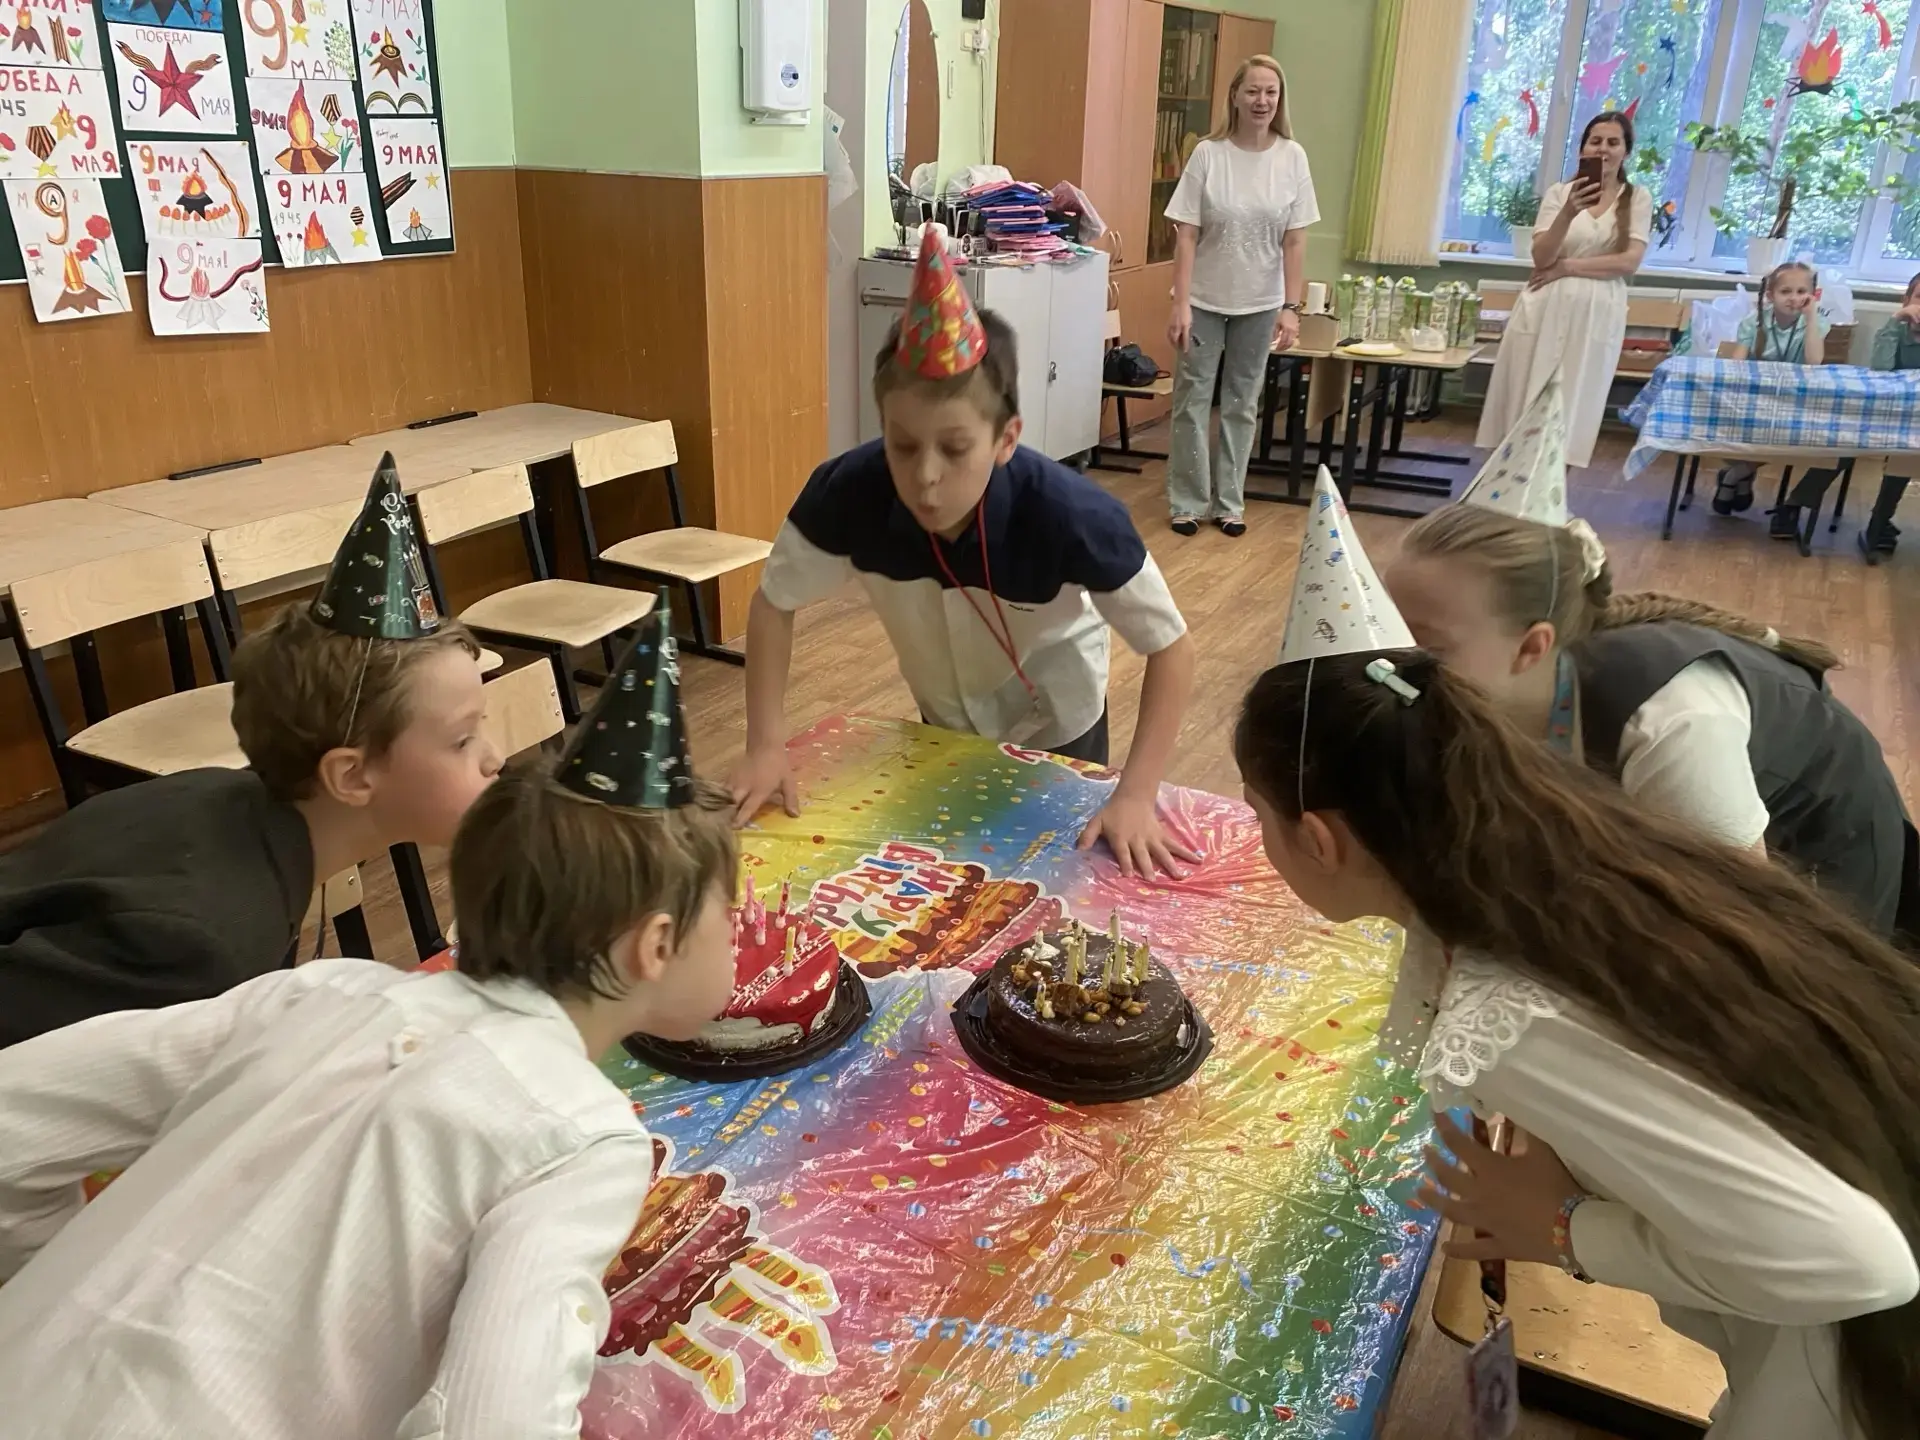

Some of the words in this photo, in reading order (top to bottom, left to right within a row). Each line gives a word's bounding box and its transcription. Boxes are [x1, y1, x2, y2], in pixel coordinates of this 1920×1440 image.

[135, 28, 192, 45] ПОБЕДА!
[291, 59, 336, 80] МАЯ
[127, 75, 147, 111] 9
[0, 98, 26, 116] 45
[201, 96, 230, 115] МАЯ
[76, 114, 97, 150] 9
[71, 151, 118, 173] МАЯ
[382, 144, 394, 165] 9
[398, 144, 438, 165] МАЯ
[277, 179, 292, 208] 9
[302, 179, 347, 205] МАЯ
[274, 211, 301, 225] 1945
[176, 242, 194, 275] 9
